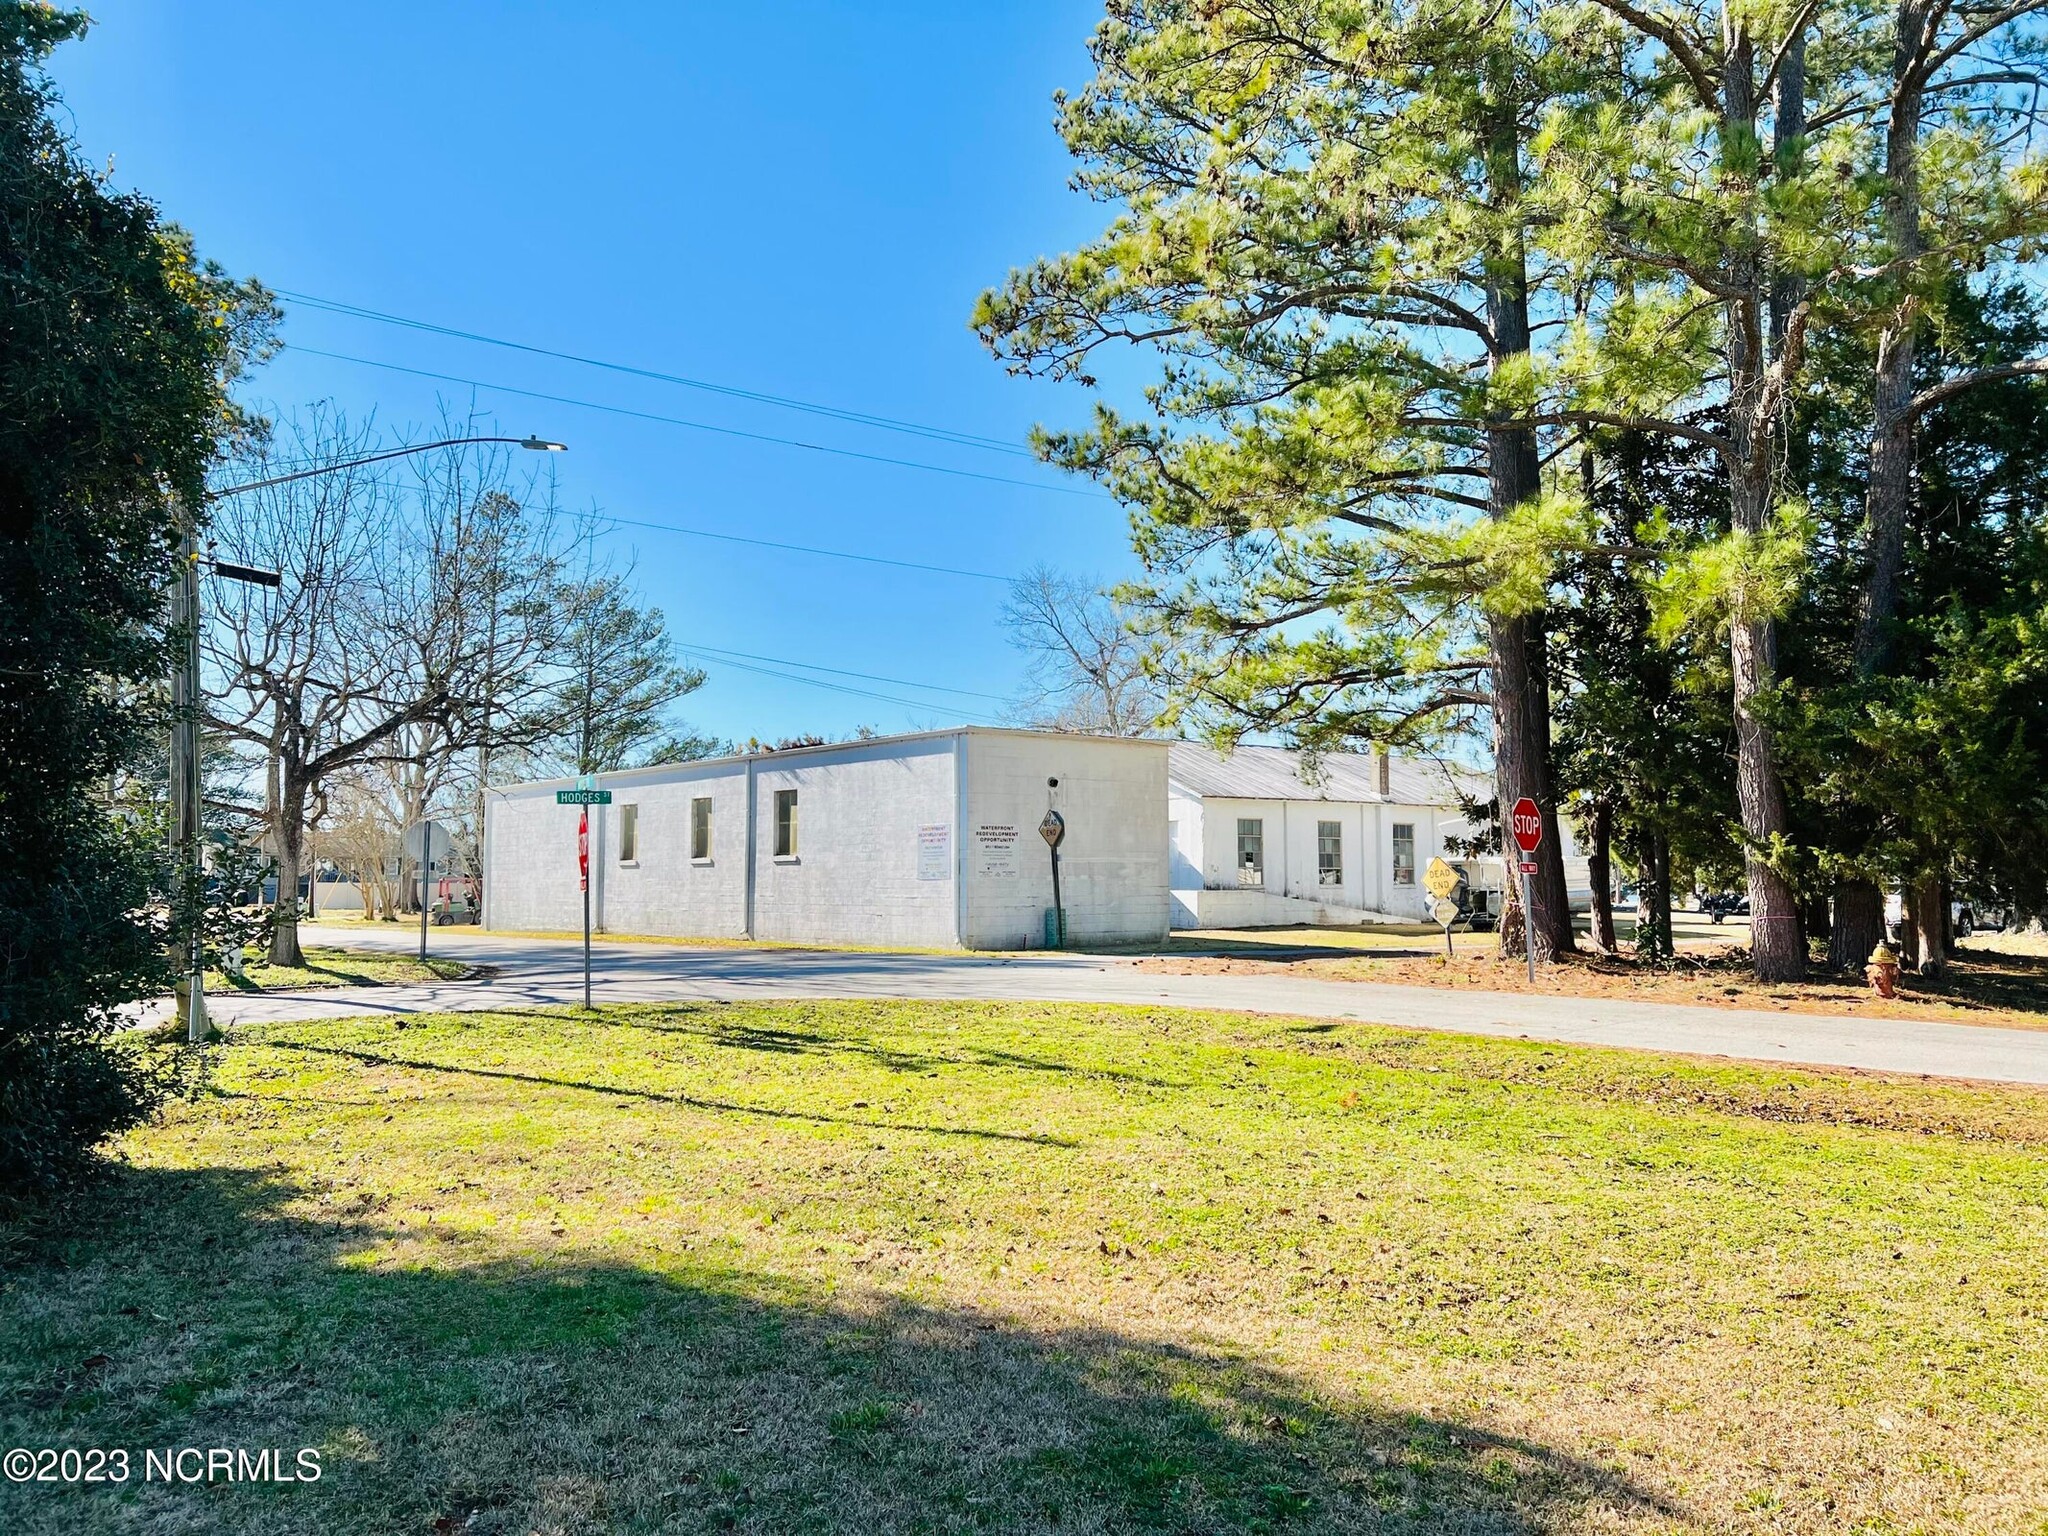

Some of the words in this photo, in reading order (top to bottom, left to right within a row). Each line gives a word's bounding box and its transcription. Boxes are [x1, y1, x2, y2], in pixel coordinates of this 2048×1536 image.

[561, 792, 600, 803] HODGES
[1514, 814, 1540, 835] STOP
[1046, 829, 1056, 837] END
[1429, 868, 1451, 879] DEAD
[1433, 881, 1450, 890] END
